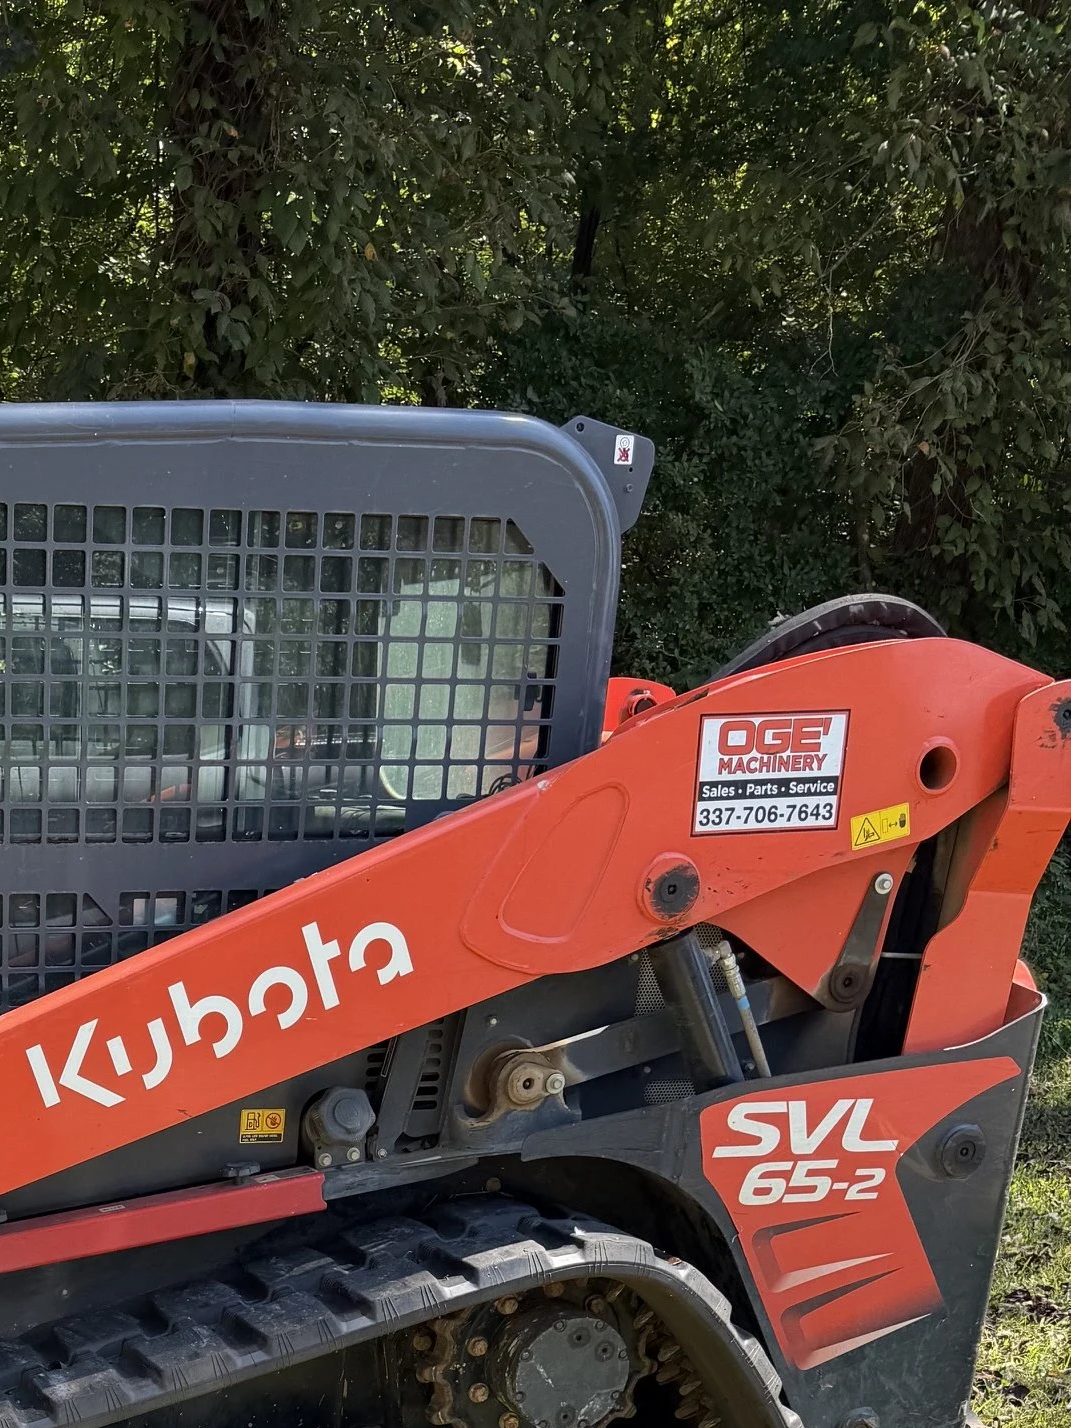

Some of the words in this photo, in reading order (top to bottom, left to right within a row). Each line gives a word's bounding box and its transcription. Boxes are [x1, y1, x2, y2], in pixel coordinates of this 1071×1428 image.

[718, 754, 828, 775] MACHINERY
[702, 785, 735, 797] Sales
[746, 782, 778, 796] Parts
[789, 780, 834, 794] Service
[699, 802, 834, 827] 337-706-7643
[26, 921, 414, 1108] Kubota
[712, 1098, 899, 1159] SVL
[738, 1159, 886, 1206] 65-2
